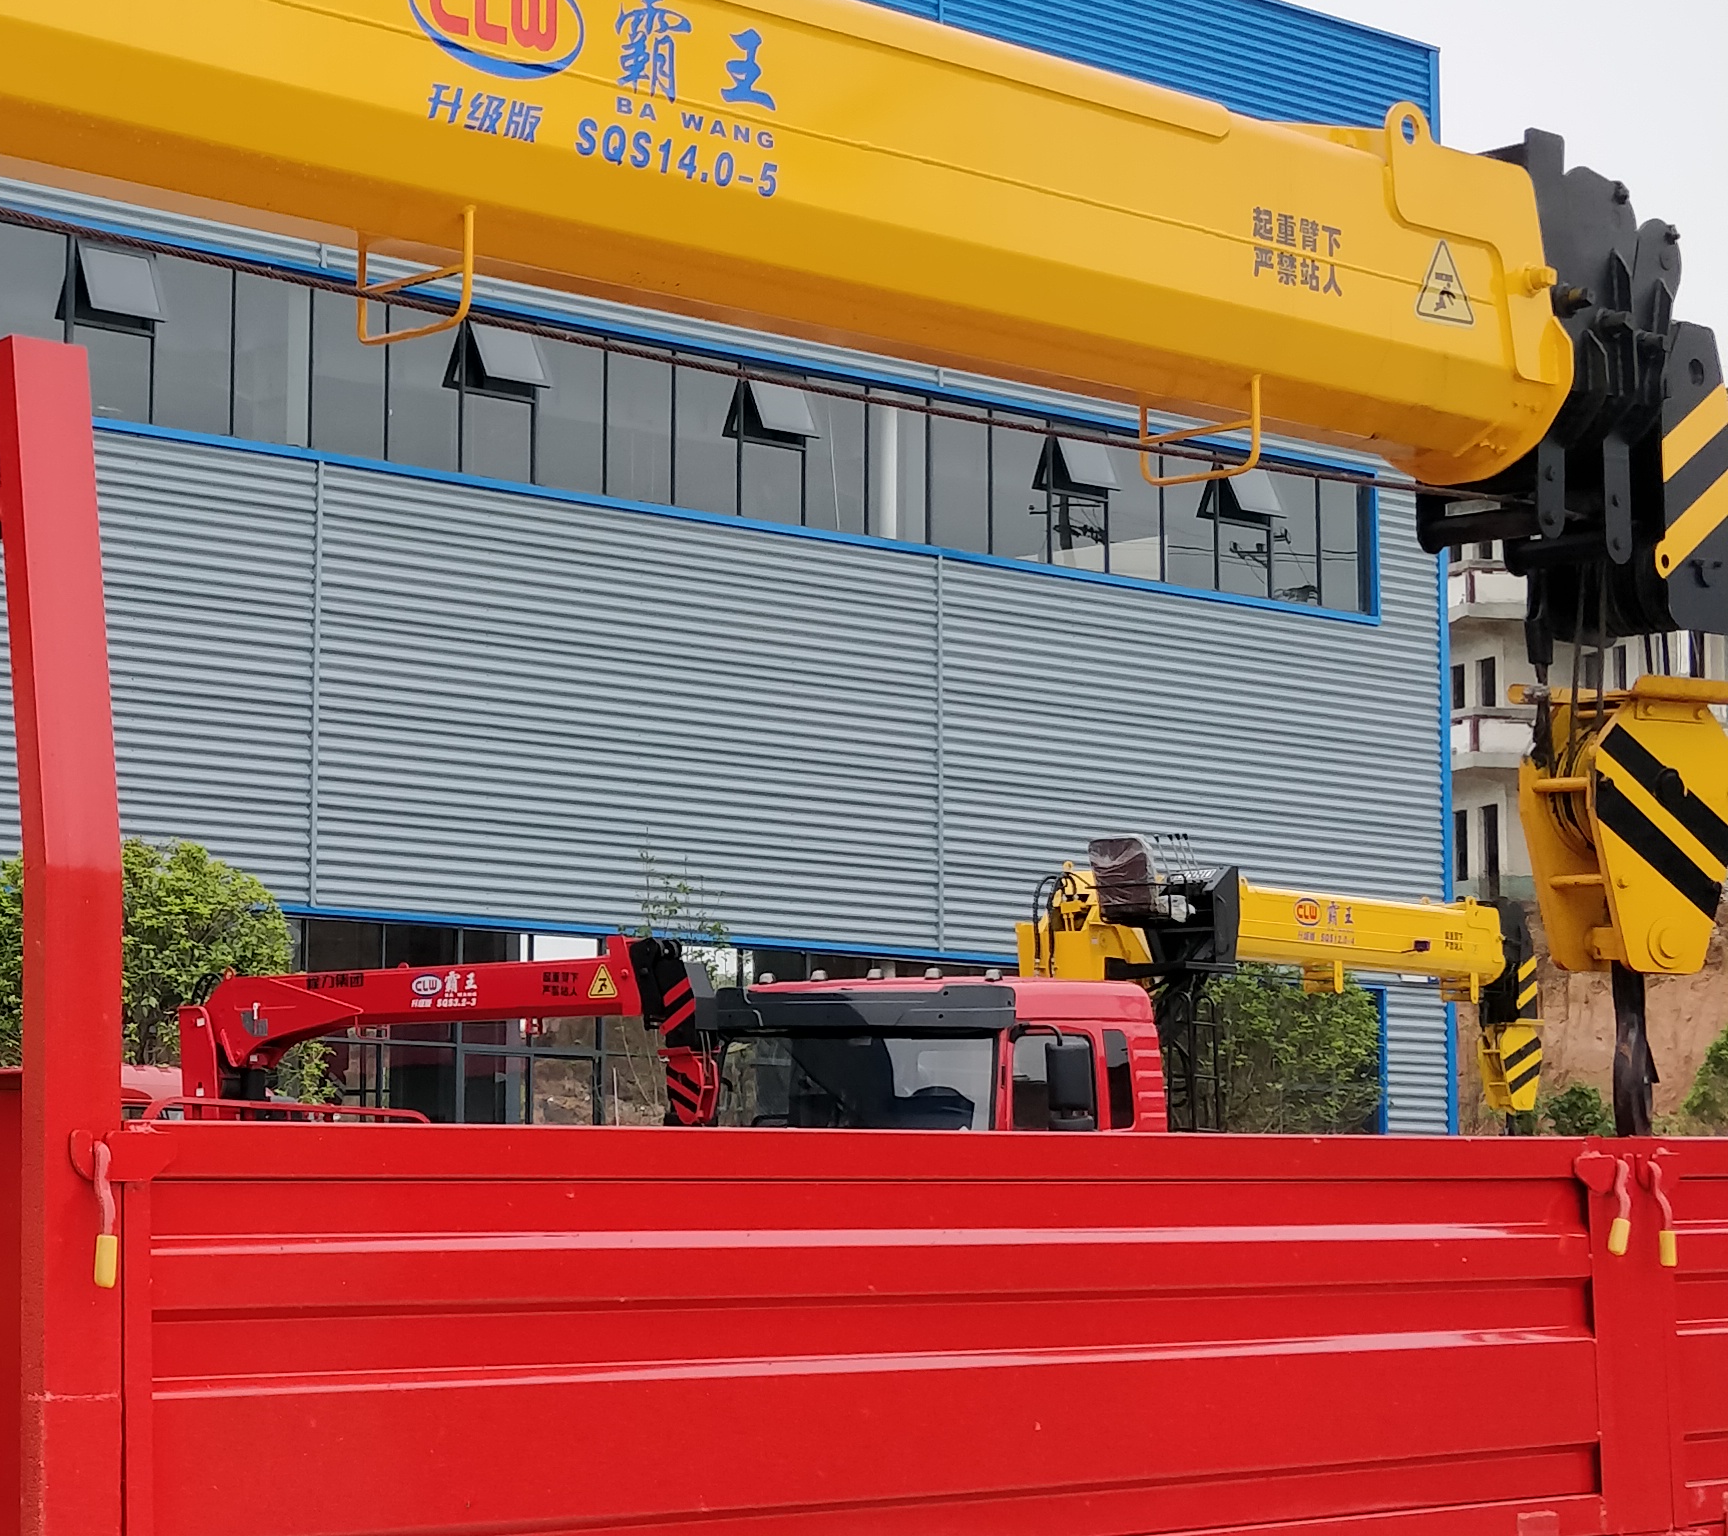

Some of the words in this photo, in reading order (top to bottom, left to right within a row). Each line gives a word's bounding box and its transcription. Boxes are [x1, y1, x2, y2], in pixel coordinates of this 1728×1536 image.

[428, 83, 543, 143] 升级版
[616, 96, 656, 121] BA
[681, 112, 774, 149] WANG
[575, 118, 778, 198] SQS14.0-5
[1252, 206, 1342, 257] 起重臂下
[1253, 246, 1343, 297] 严禁站人
[1297, 904, 1318, 920] CLW
[415, 979, 438, 992] CLW
